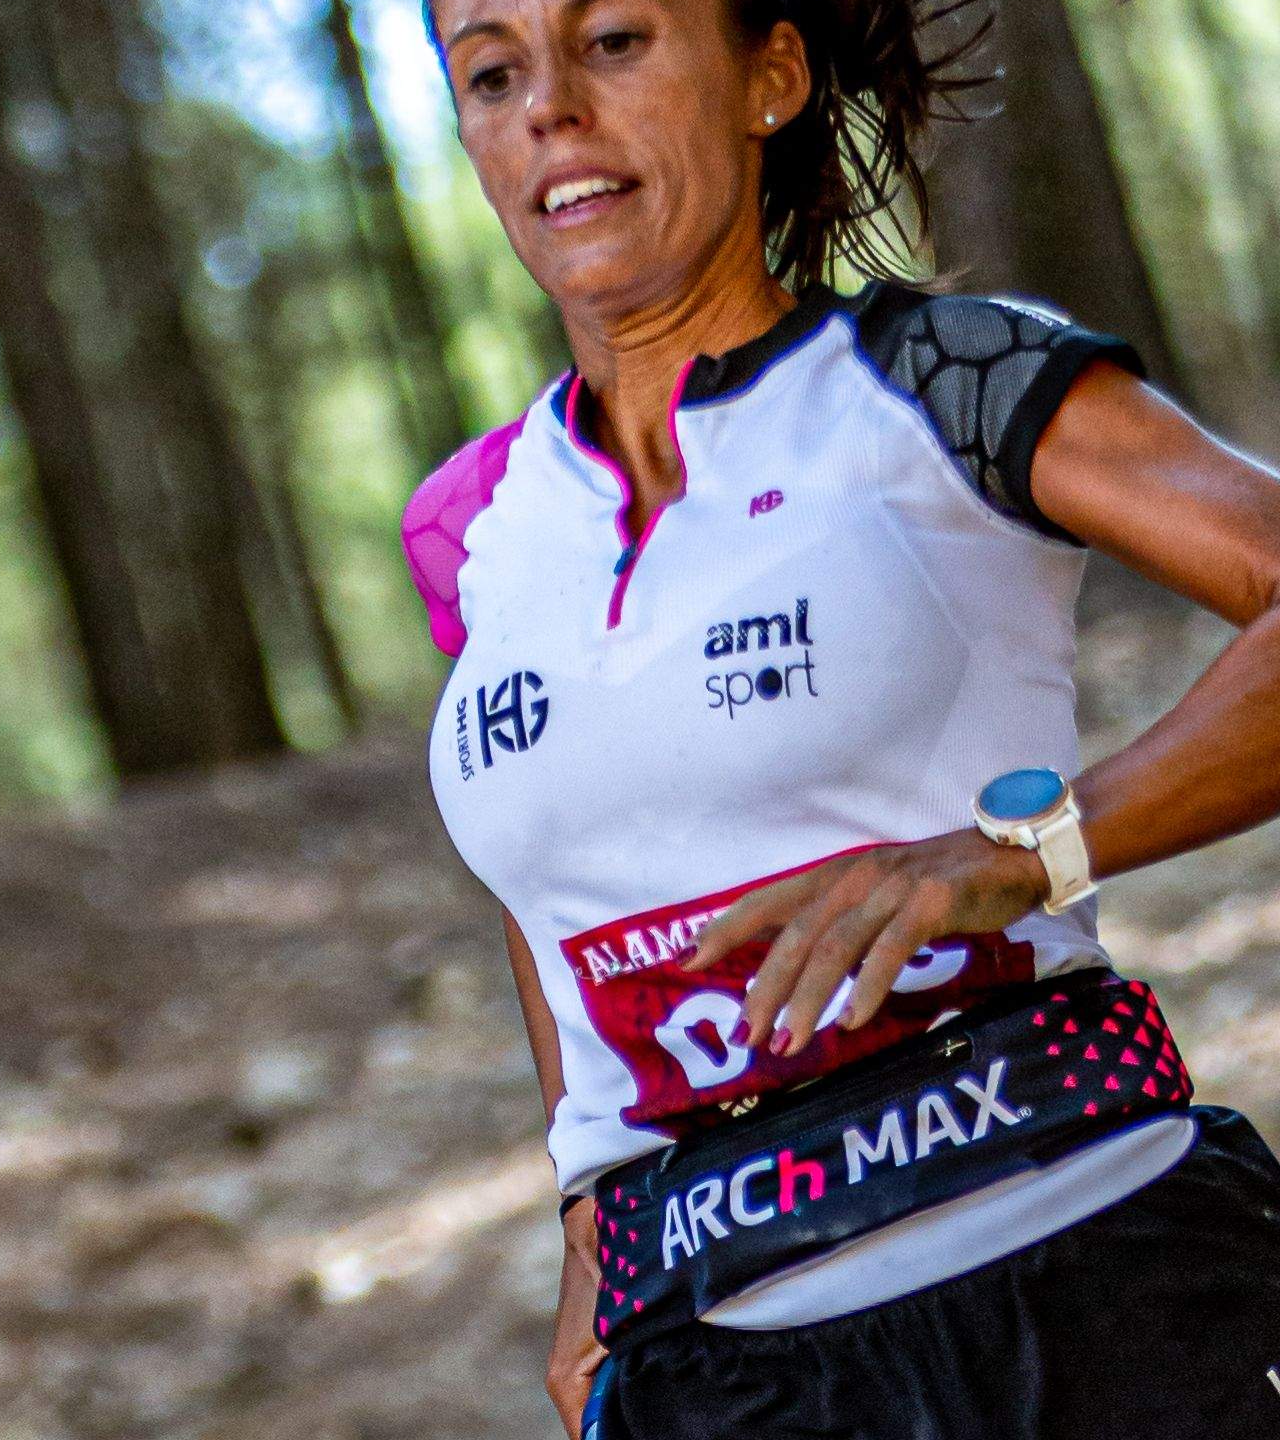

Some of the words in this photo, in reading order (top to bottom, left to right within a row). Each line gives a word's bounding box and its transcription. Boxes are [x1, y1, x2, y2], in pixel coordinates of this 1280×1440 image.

[704, 596, 814, 660] aml
[705, 649, 819, 721] sport
[661, 1149, 826, 1271] ARCh
